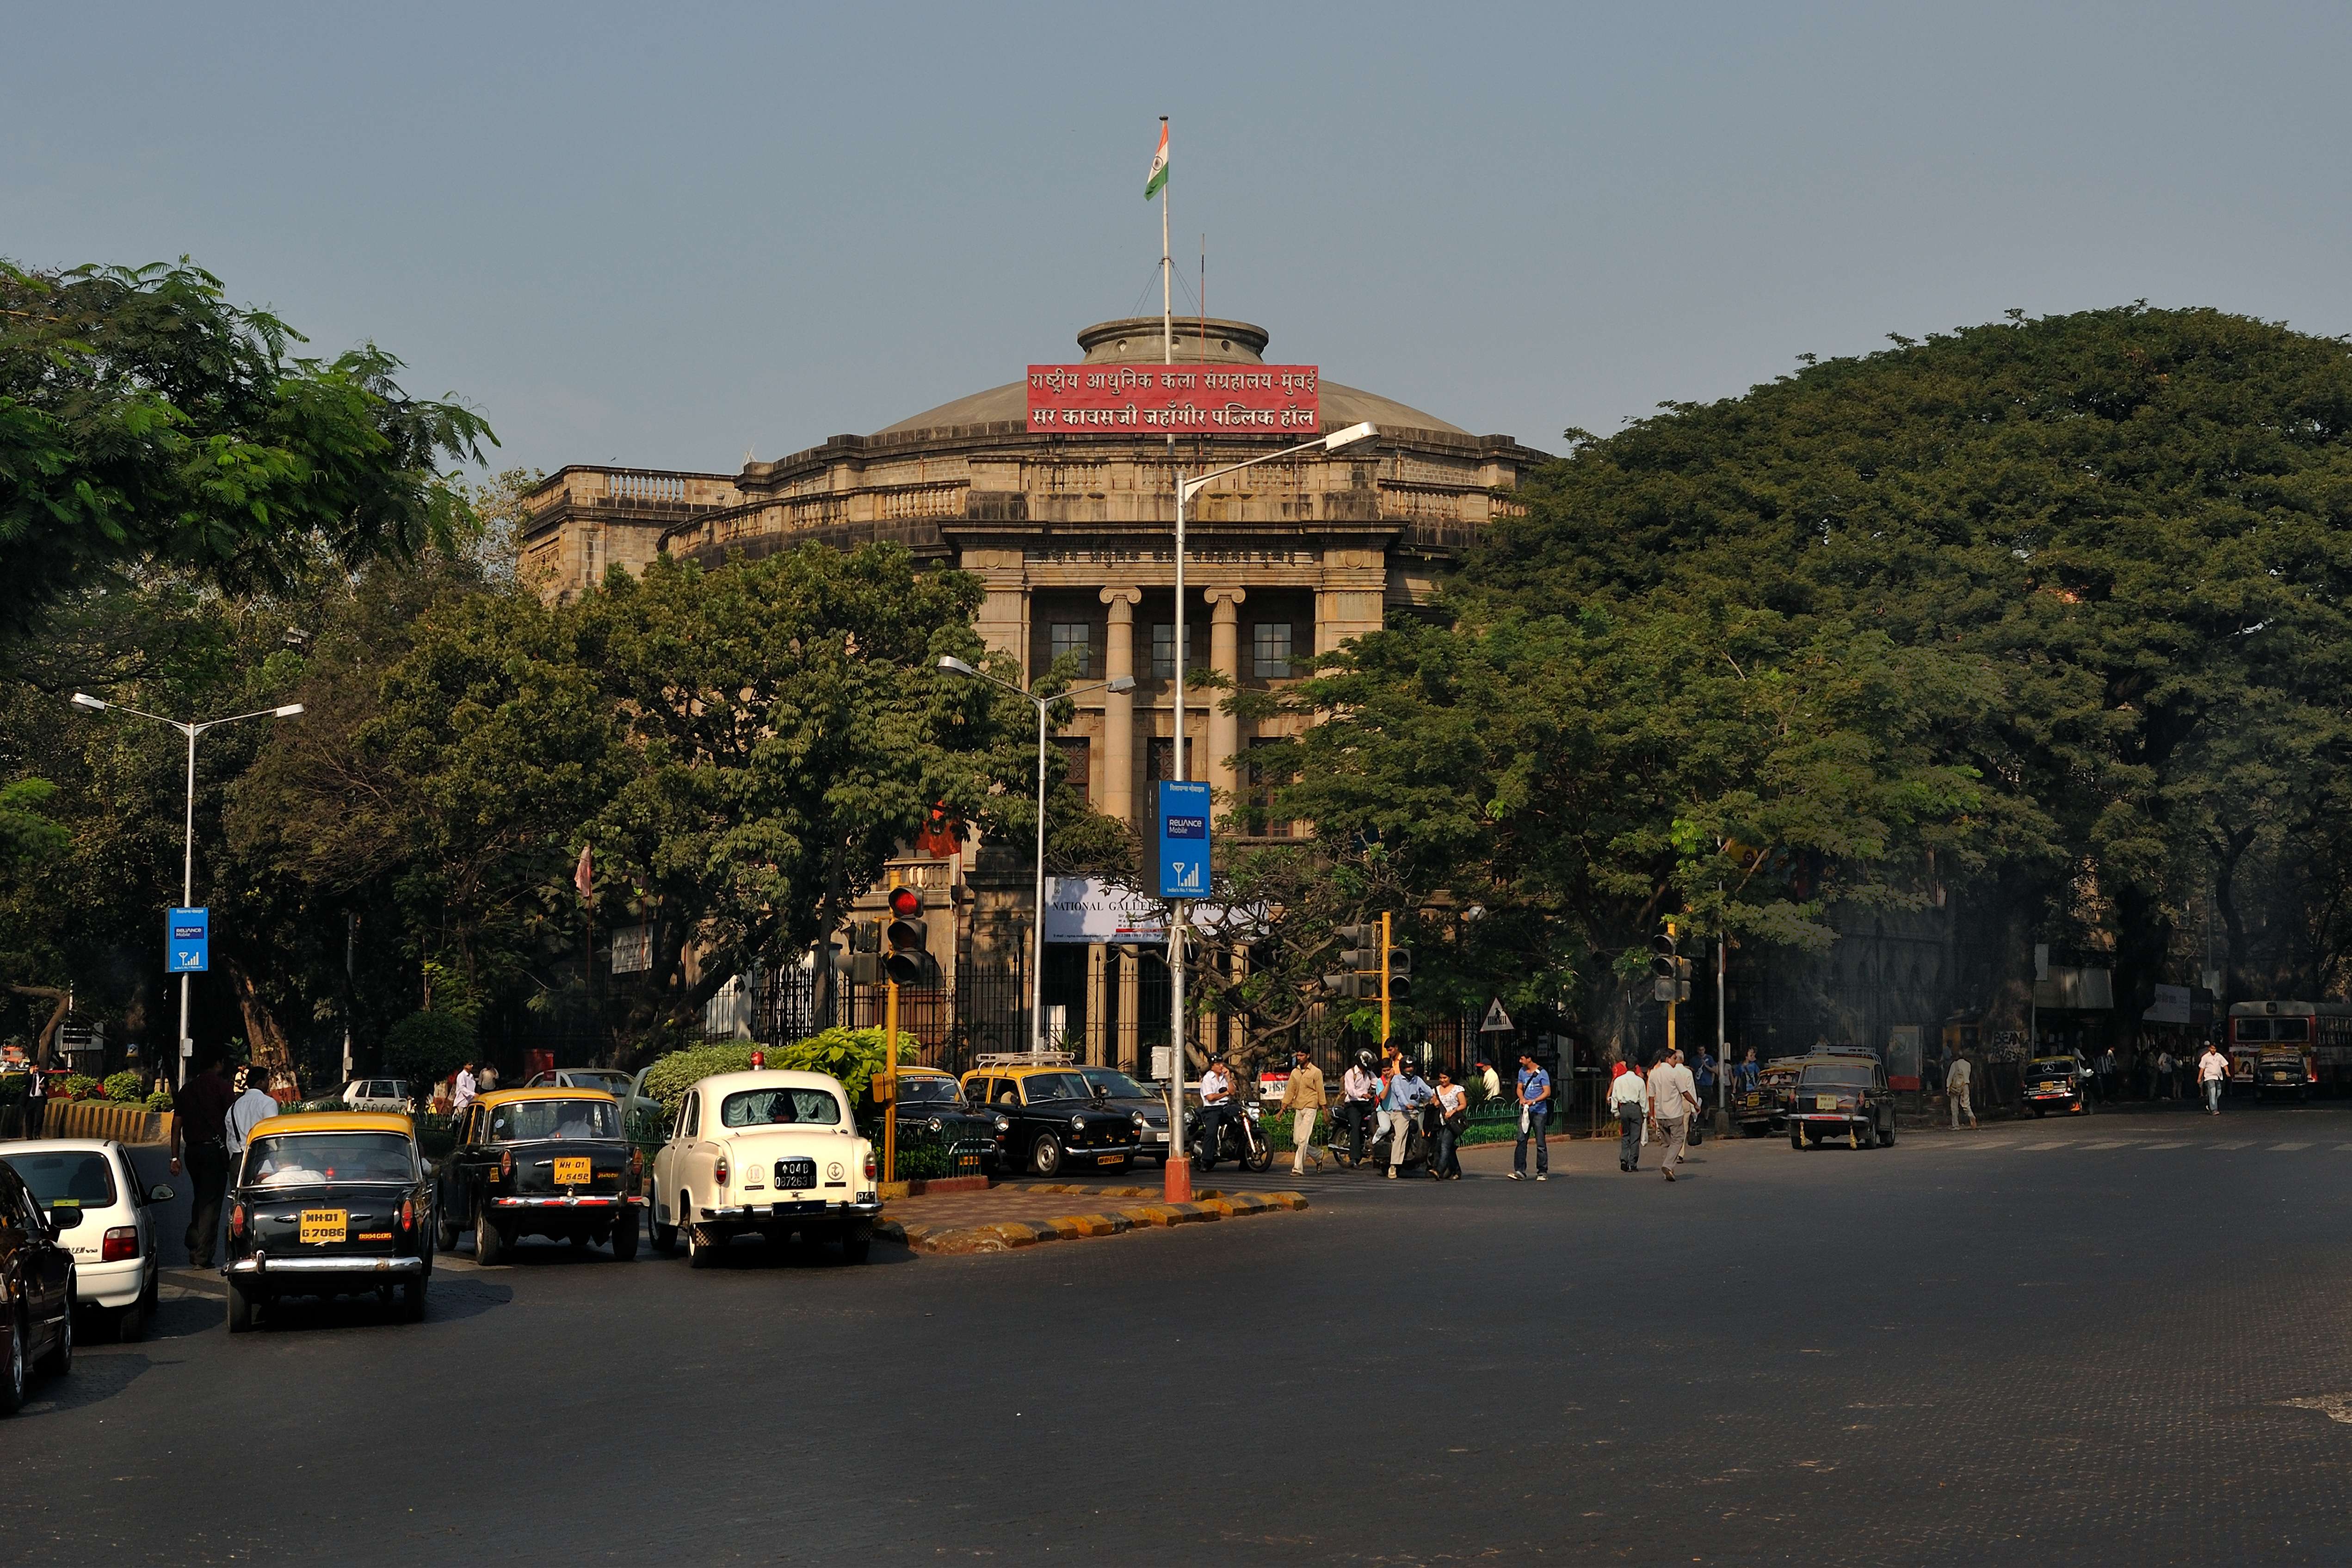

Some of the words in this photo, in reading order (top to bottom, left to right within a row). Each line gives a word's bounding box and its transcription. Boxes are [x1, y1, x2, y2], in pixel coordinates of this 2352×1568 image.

[1030, 368, 1080, 393] राष्ट्रीय
[1086, 368, 1154, 395] आधुनिक
[1161, 373, 1197, 389] कला
[1032, 408, 1056, 426] सर
[1062, 401, 1138, 426] कावसजी
[1211, 402, 1275, 426] पब्लिक
[1280, 401, 1315, 427] हॉल
[1053, 901, 1104, 911] NATIONAL
[312, 1228, 345, 1237] 7086
